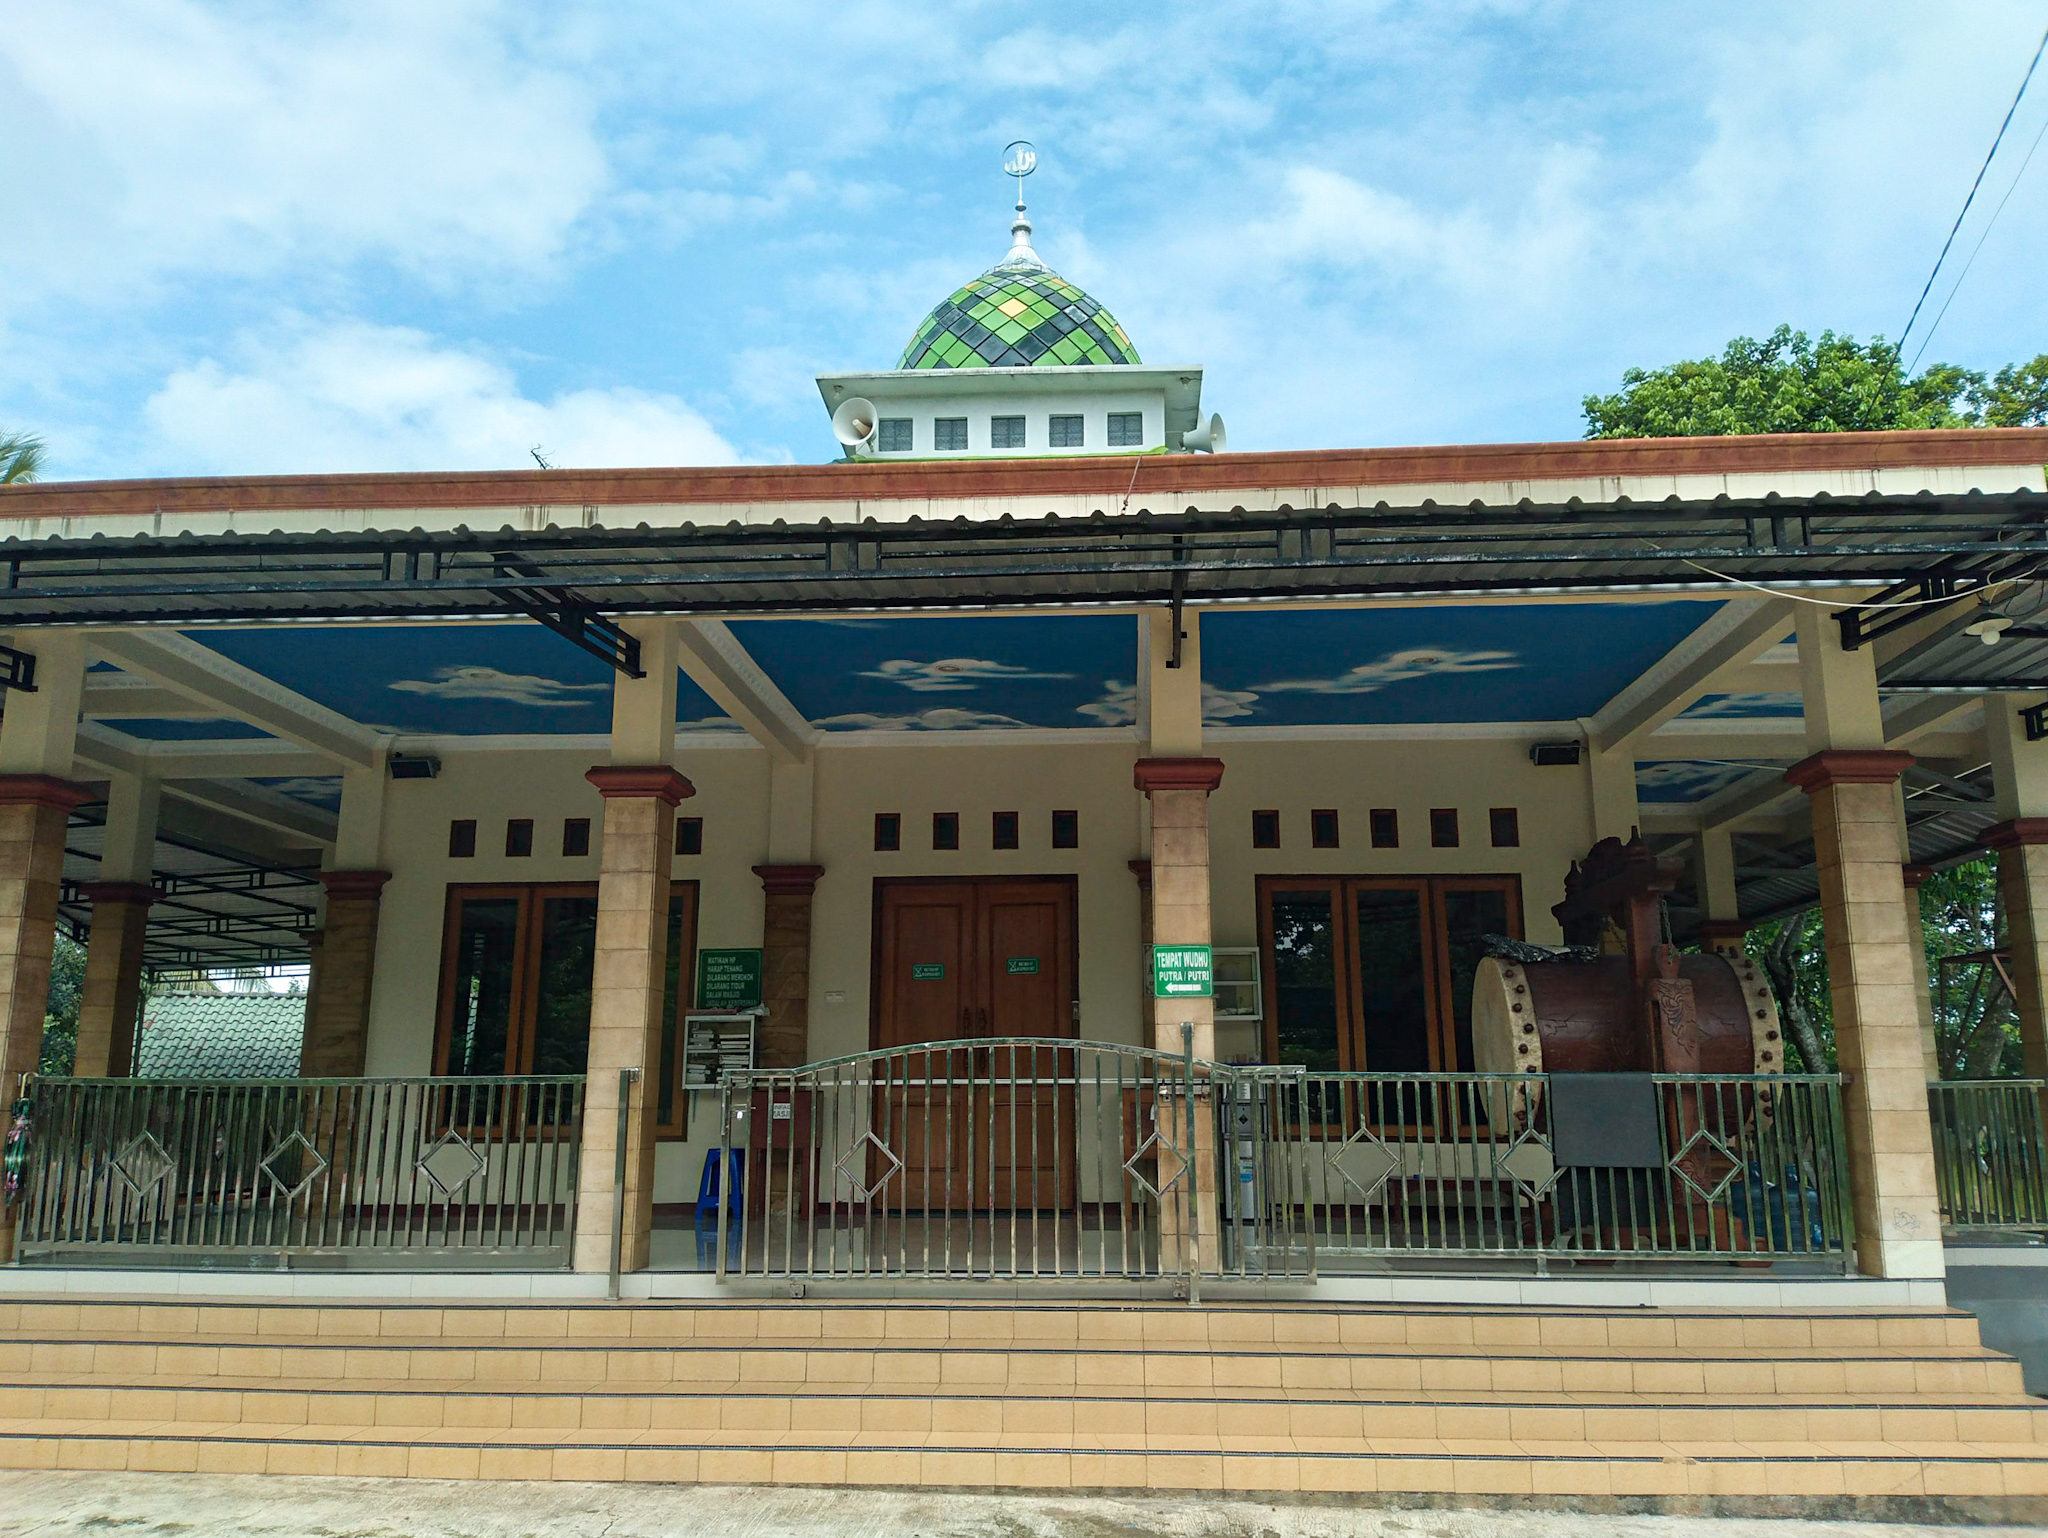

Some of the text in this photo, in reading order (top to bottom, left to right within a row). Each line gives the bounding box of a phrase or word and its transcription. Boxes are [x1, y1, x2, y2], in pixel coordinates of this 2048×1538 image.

[708, 956, 729, 964] MATIKAN
[1157, 951, 1209, 968] TEMPAT WUDHU
[1159, 971, 1183, 981] PUTRA
[1187, 970, 1210, 981] PUTRI
[706, 982, 730, 990] DILARANG
